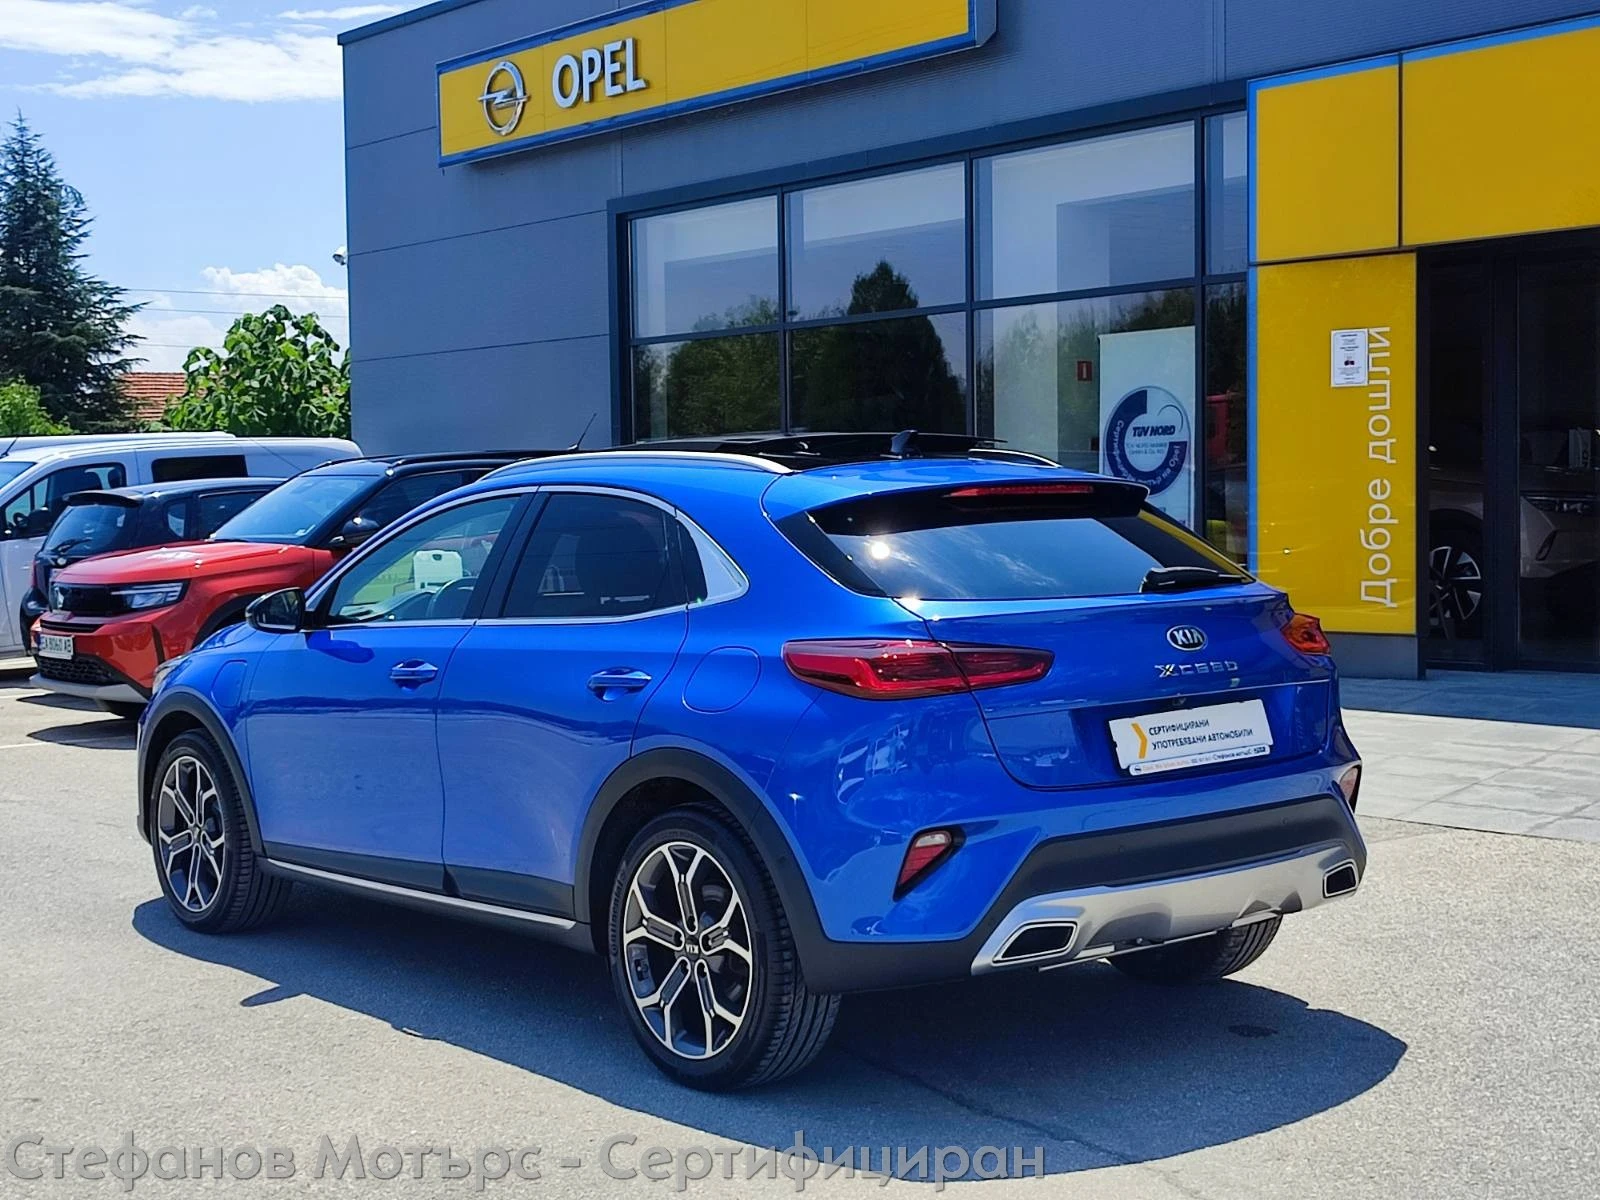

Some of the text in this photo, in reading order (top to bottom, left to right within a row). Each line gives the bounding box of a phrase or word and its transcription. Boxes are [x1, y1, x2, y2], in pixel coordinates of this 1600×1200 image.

[552, 37, 647, 108] OPEL
[1149, 425, 1176, 436] NORD
[1168, 445, 1181, 467] Opel
[1359, 326, 1399, 608] Добре дошли
[1172, 628, 1204, 645] KIA
[1148, 719, 1210, 736] СЕРТИФИЦИРАНИ
[1151, 729, 1253, 750] УПОТРЕБЯВАНИ АВТОМОБИЛИ
[685, 943, 699, 954] KIA
